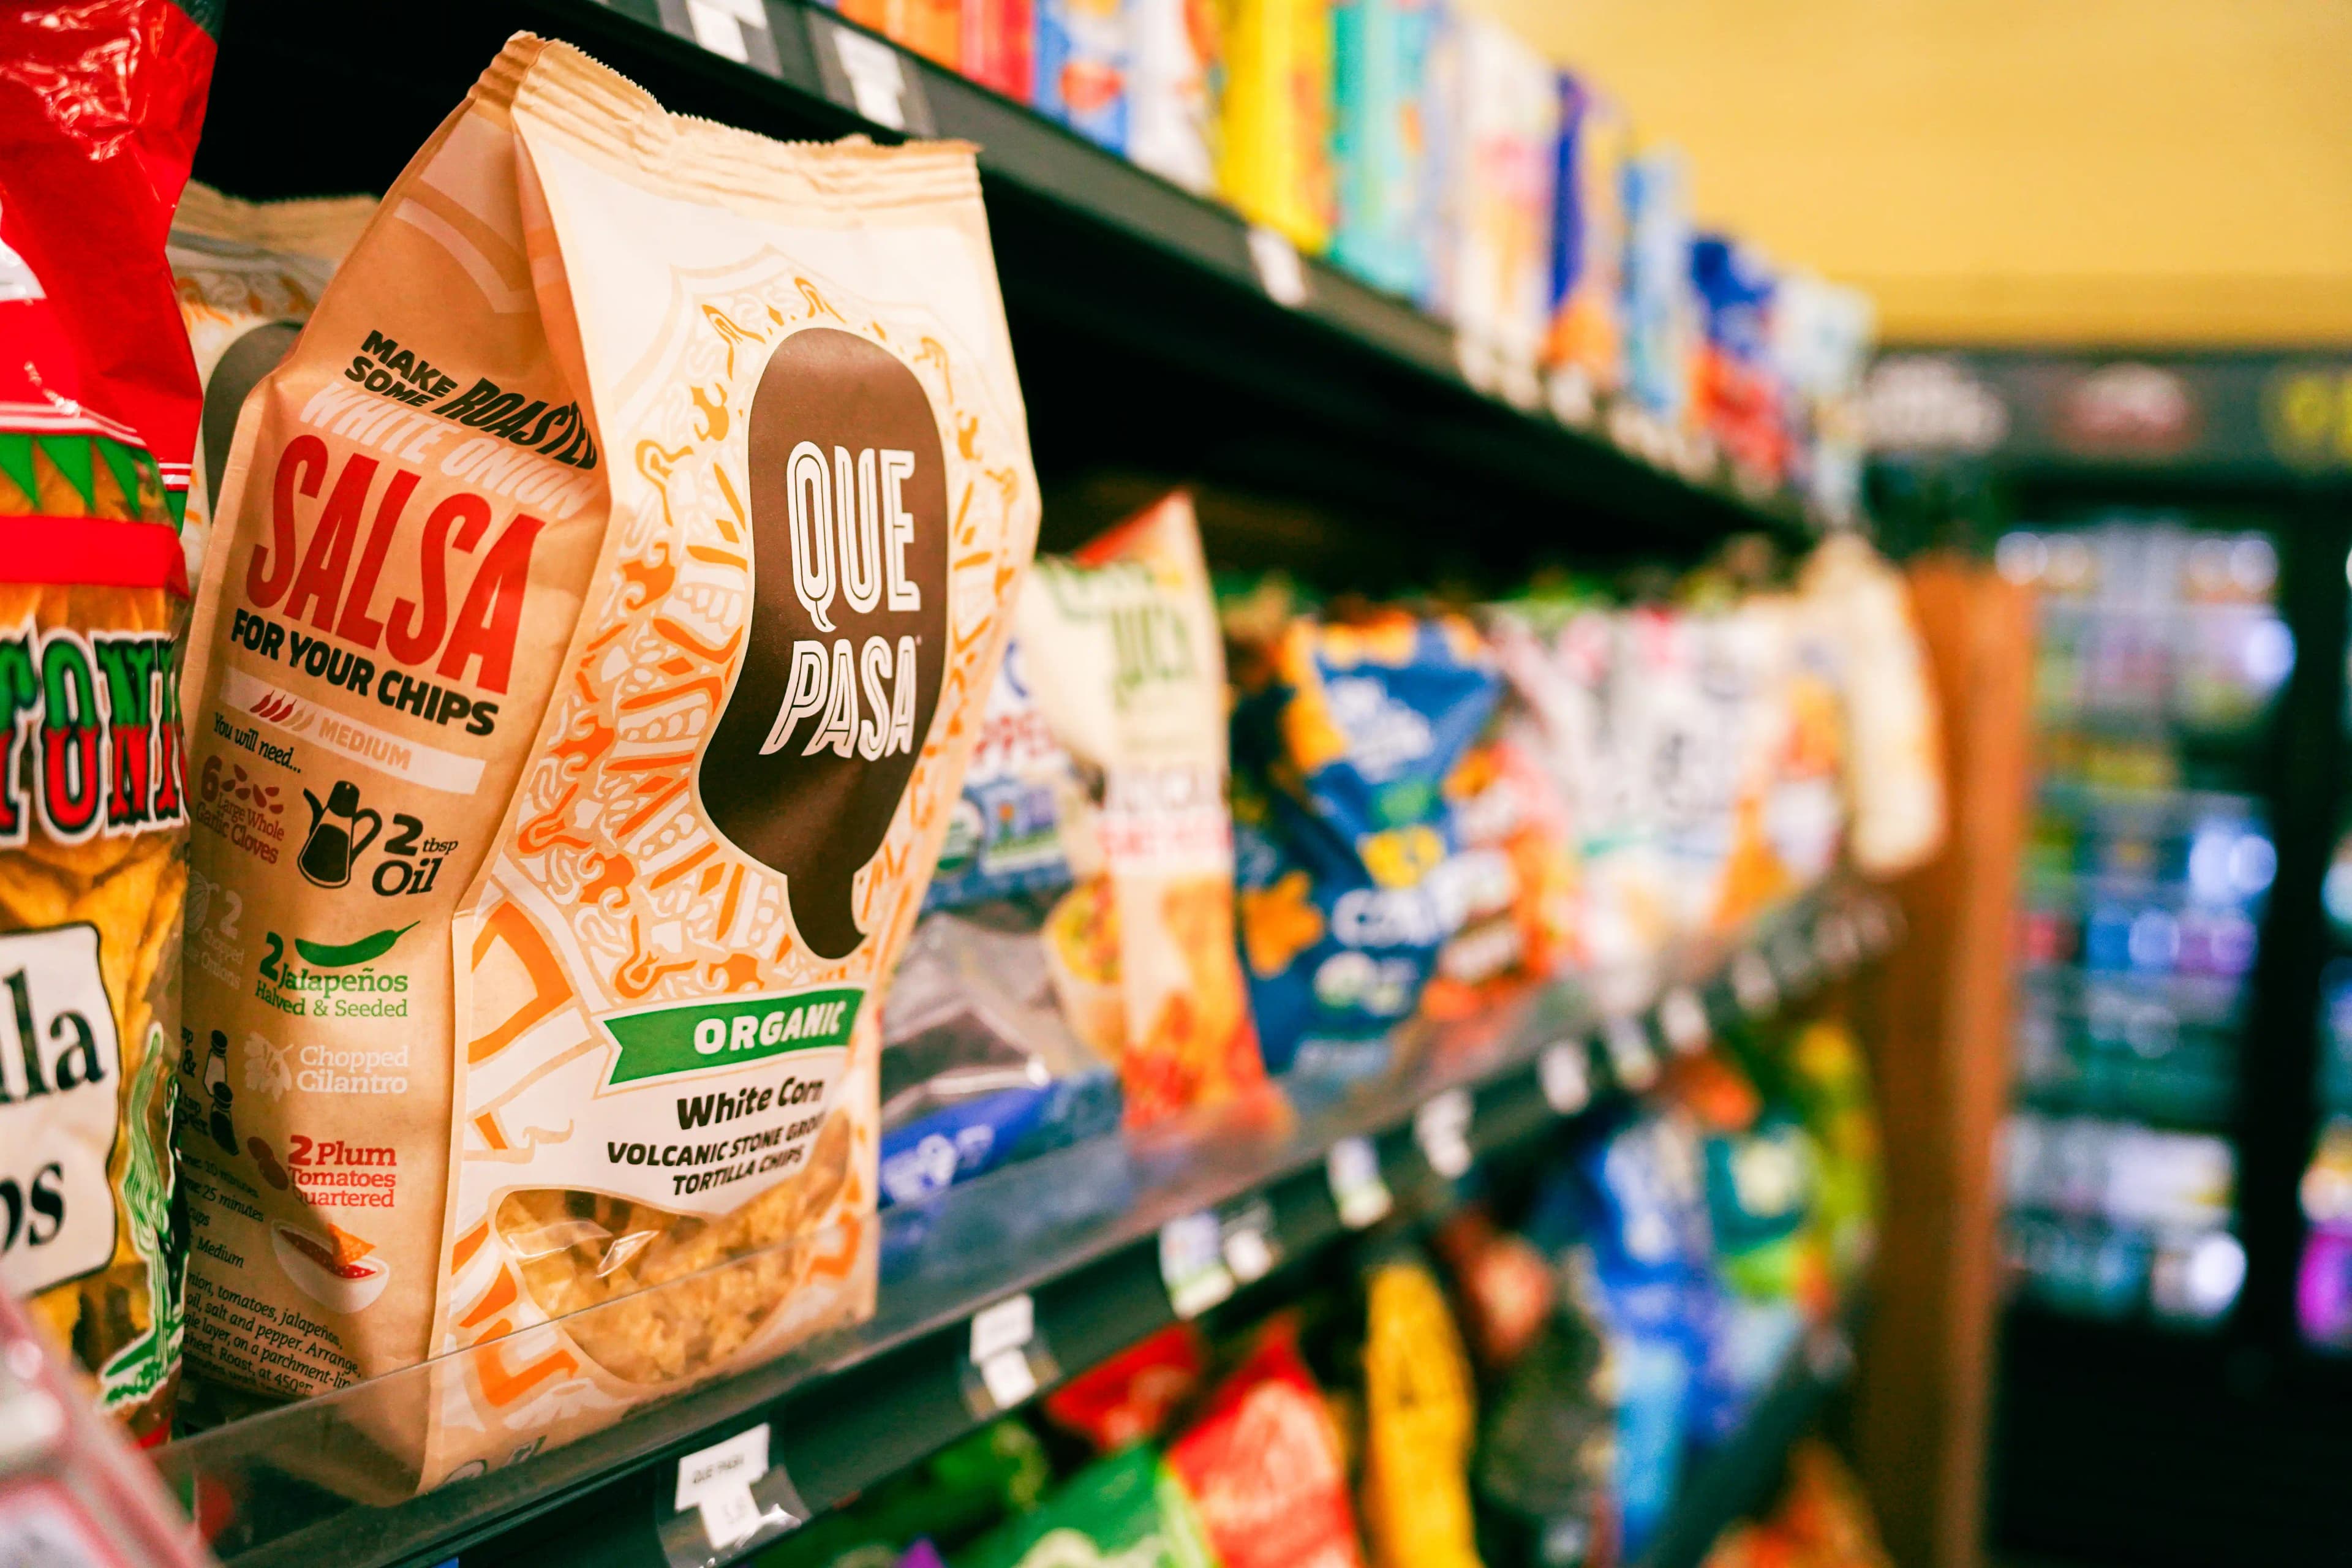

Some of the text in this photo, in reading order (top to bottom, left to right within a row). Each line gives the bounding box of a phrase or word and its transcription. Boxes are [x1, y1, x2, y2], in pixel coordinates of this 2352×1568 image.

[344, 355, 435, 407] SOME
[361, 329, 458, 398] MAKE
[432, 377, 597, 470] ROASTED
[300, 383, 598, 519] WHITE ONION
[786, 440, 921, 633] QUE
[246, 434, 546, 695] SALSA
[231, 608, 500, 737] FOR YOUR CHIPS
[758, 635, 916, 762] PASA
[0, 620, 190, 845] TONI
[214, 712, 301, 774] You will need...
[318, 717, 412, 771] MEDIUM
[201, 755, 222, 802] 6
[195, 802, 279, 865] Garlic Cloves
[217, 793, 285, 842] Large Whole
[384, 813, 458, 856] 2 tbsp
[372, 858, 443, 897] Oil
[219, 889, 243, 940] 2
[259, 931, 284, 982] 2
[278, 963, 409, 998] Jalapeños
[255, 981, 409, 1017] Halved & Seeded
[693, 1001, 846, 1055] ORGANIC
[296, 1069, 409, 1095] Cilantro
[300, 1045, 409, 1072] Chopped
[676, 1076, 825, 1131] White Corn
[288, 1134, 397, 1166] 2 Plum
[607, 1140, 729, 1167] VOLCANIC
[729, 1126, 783, 1158] STONE
[673, 1144, 805, 1196] TORTILLA CHIPS
[288, 1166, 396, 1188] Tomatoes
[203, 1185, 217, 1202] 25
[219, 1194, 264, 1222] minutes
[197, 1235, 244, 1268] Medium
[186, 1272, 214, 1297] nion,
[218, 1284, 277, 1322] tomatoes,
[186, 1292, 202, 1312] oil,
[205, 1303, 228, 1322] salt
[230, 1313, 256, 1332] and
[255, 1324, 303, 1351] pepper.
[184, 1311, 201, 1329] gle
[202, 1317, 232, 1346] layer,
[234, 1336, 248, 1351] on
[251, 1344, 260, 1356] a
[260, 1346, 351, 1389] parchment-lin
[258, 1368, 272, 1381] at
